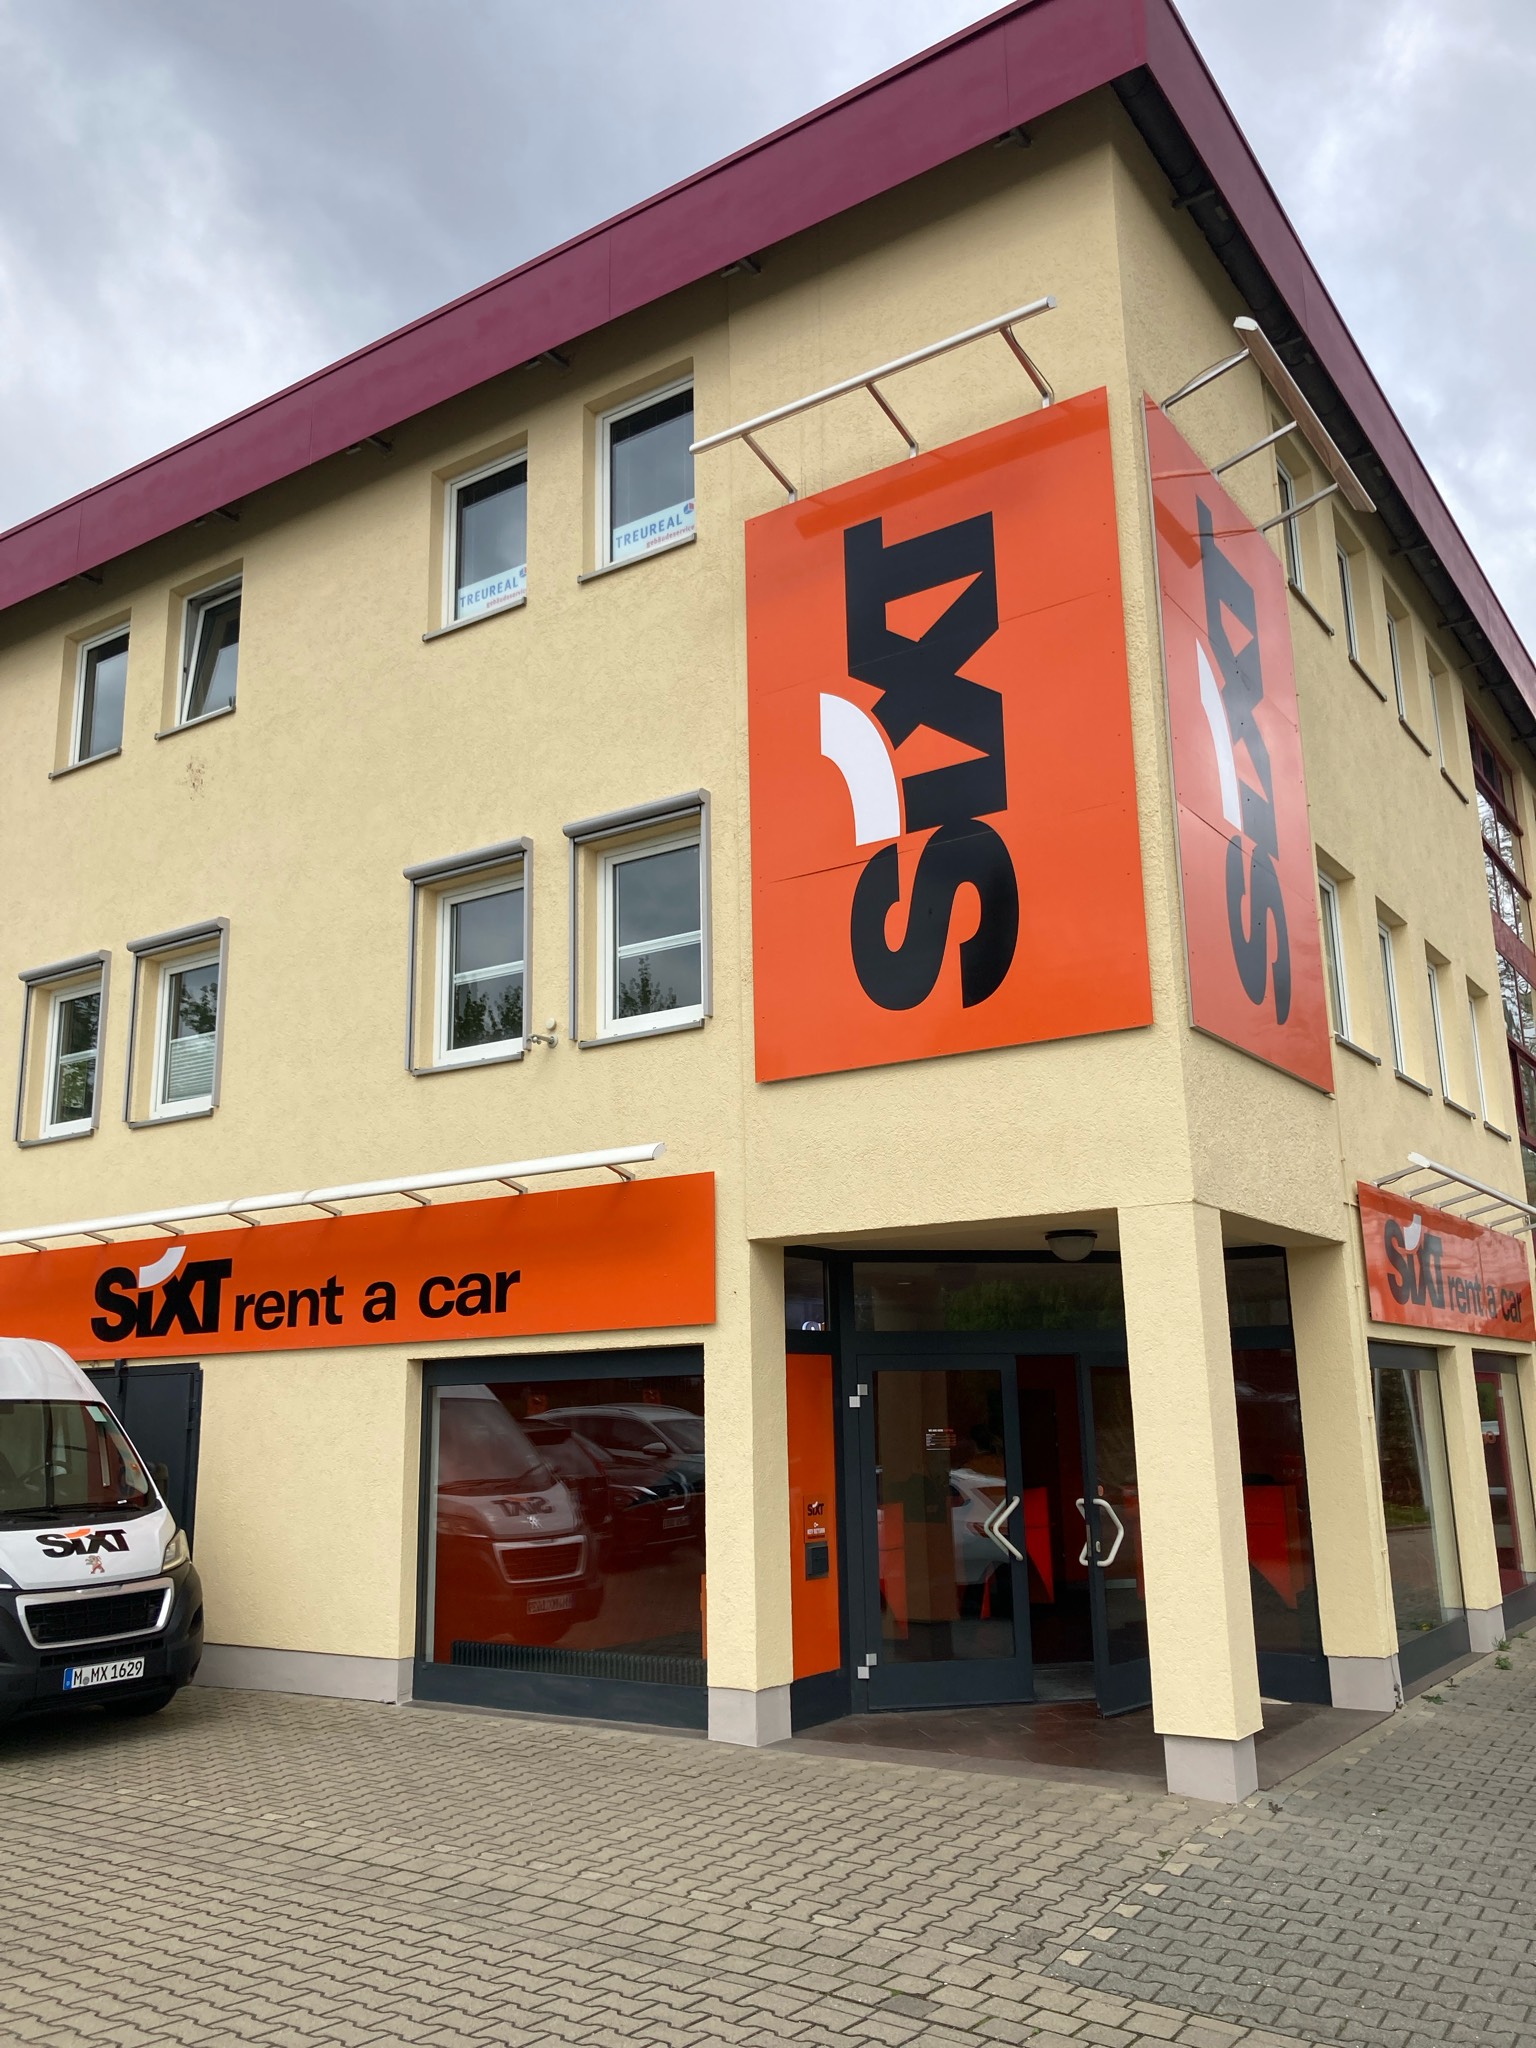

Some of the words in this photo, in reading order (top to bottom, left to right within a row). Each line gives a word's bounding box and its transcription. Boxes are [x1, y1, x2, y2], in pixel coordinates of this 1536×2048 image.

[615, 514, 682, 548] TREUREAL
[460, 577, 519, 608] TREUREAL
[234, 1275, 344, 1332] rent
[362, 1281, 396, 1323] a
[418, 1270, 521, 1319] car
[1447, 1274, 1484, 1316] rent
[1486, 1286, 1498, 1319] a
[1500, 1288, 1522, 1324] car
[110, 1660, 143, 1679] 1629
